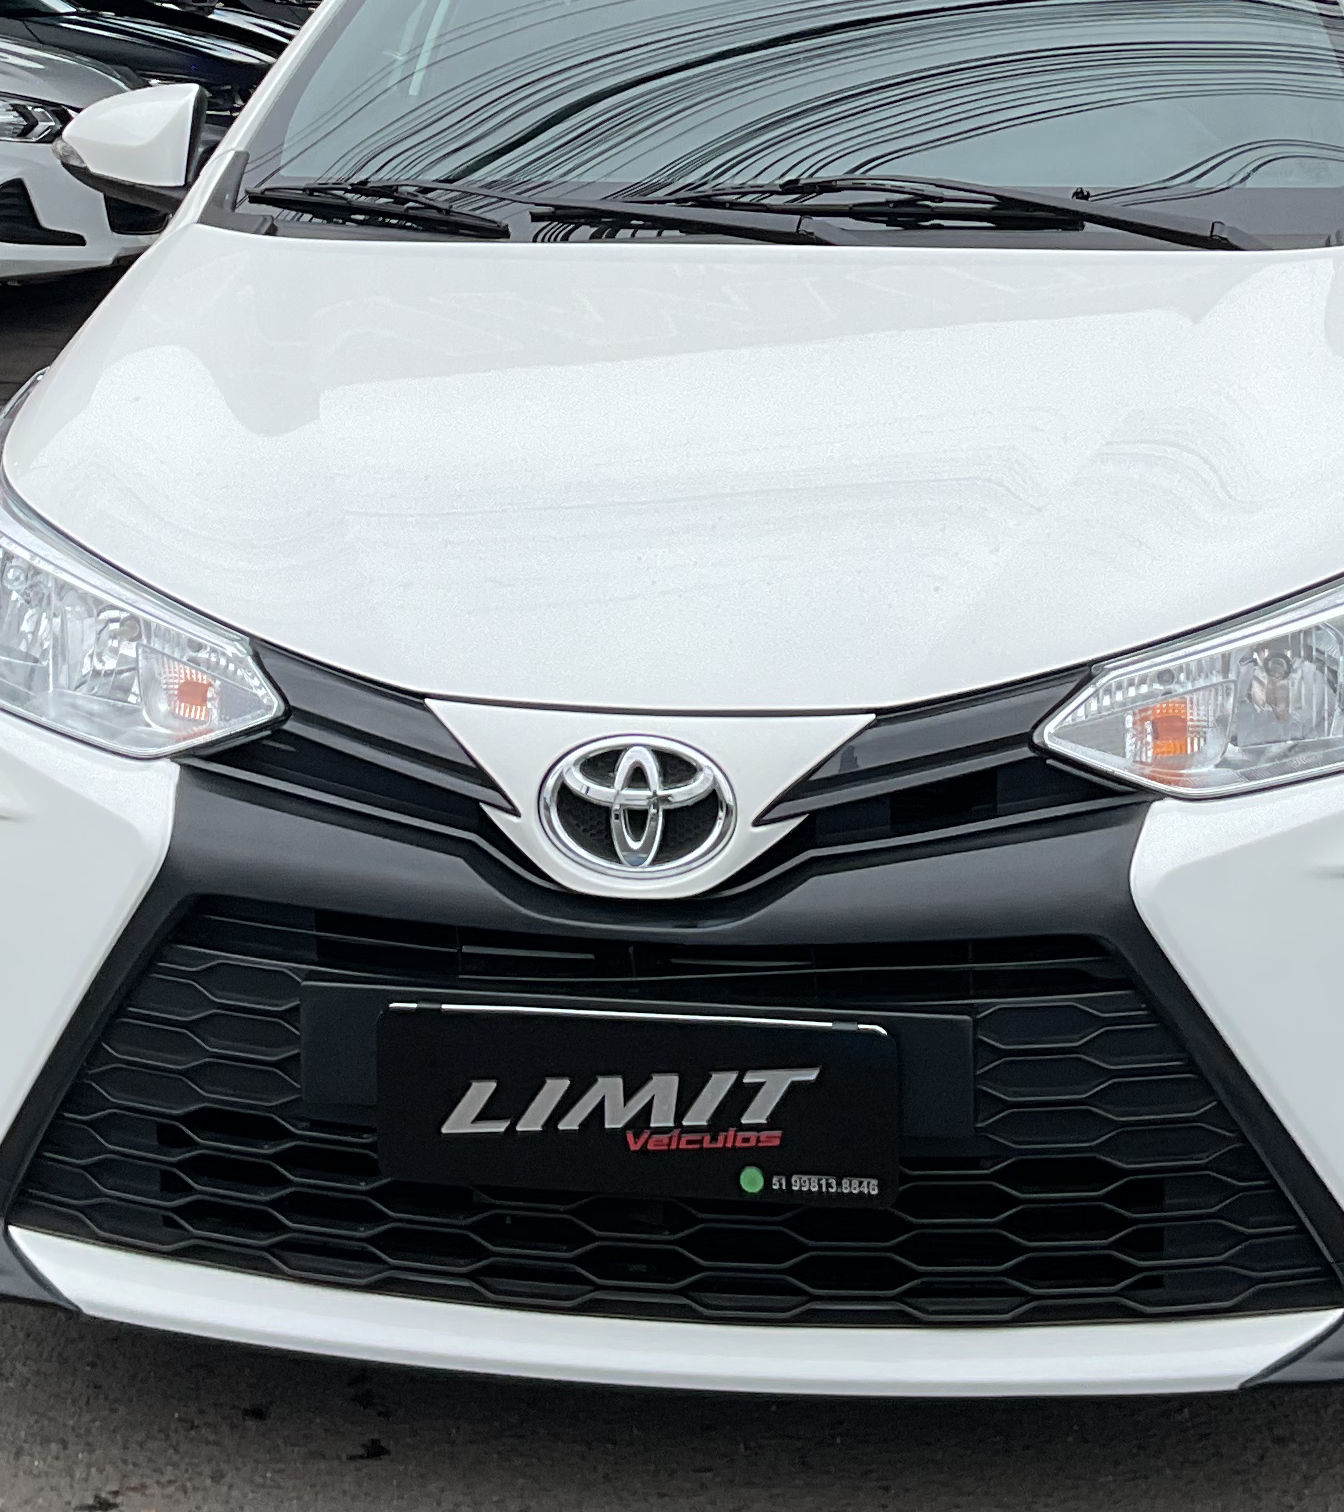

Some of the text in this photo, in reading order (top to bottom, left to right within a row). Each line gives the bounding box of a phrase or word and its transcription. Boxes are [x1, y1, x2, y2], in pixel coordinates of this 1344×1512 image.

[441, 1066, 821, 1133] LIMIT
[772, 1174, 879, 1195] 51 99813.8846
